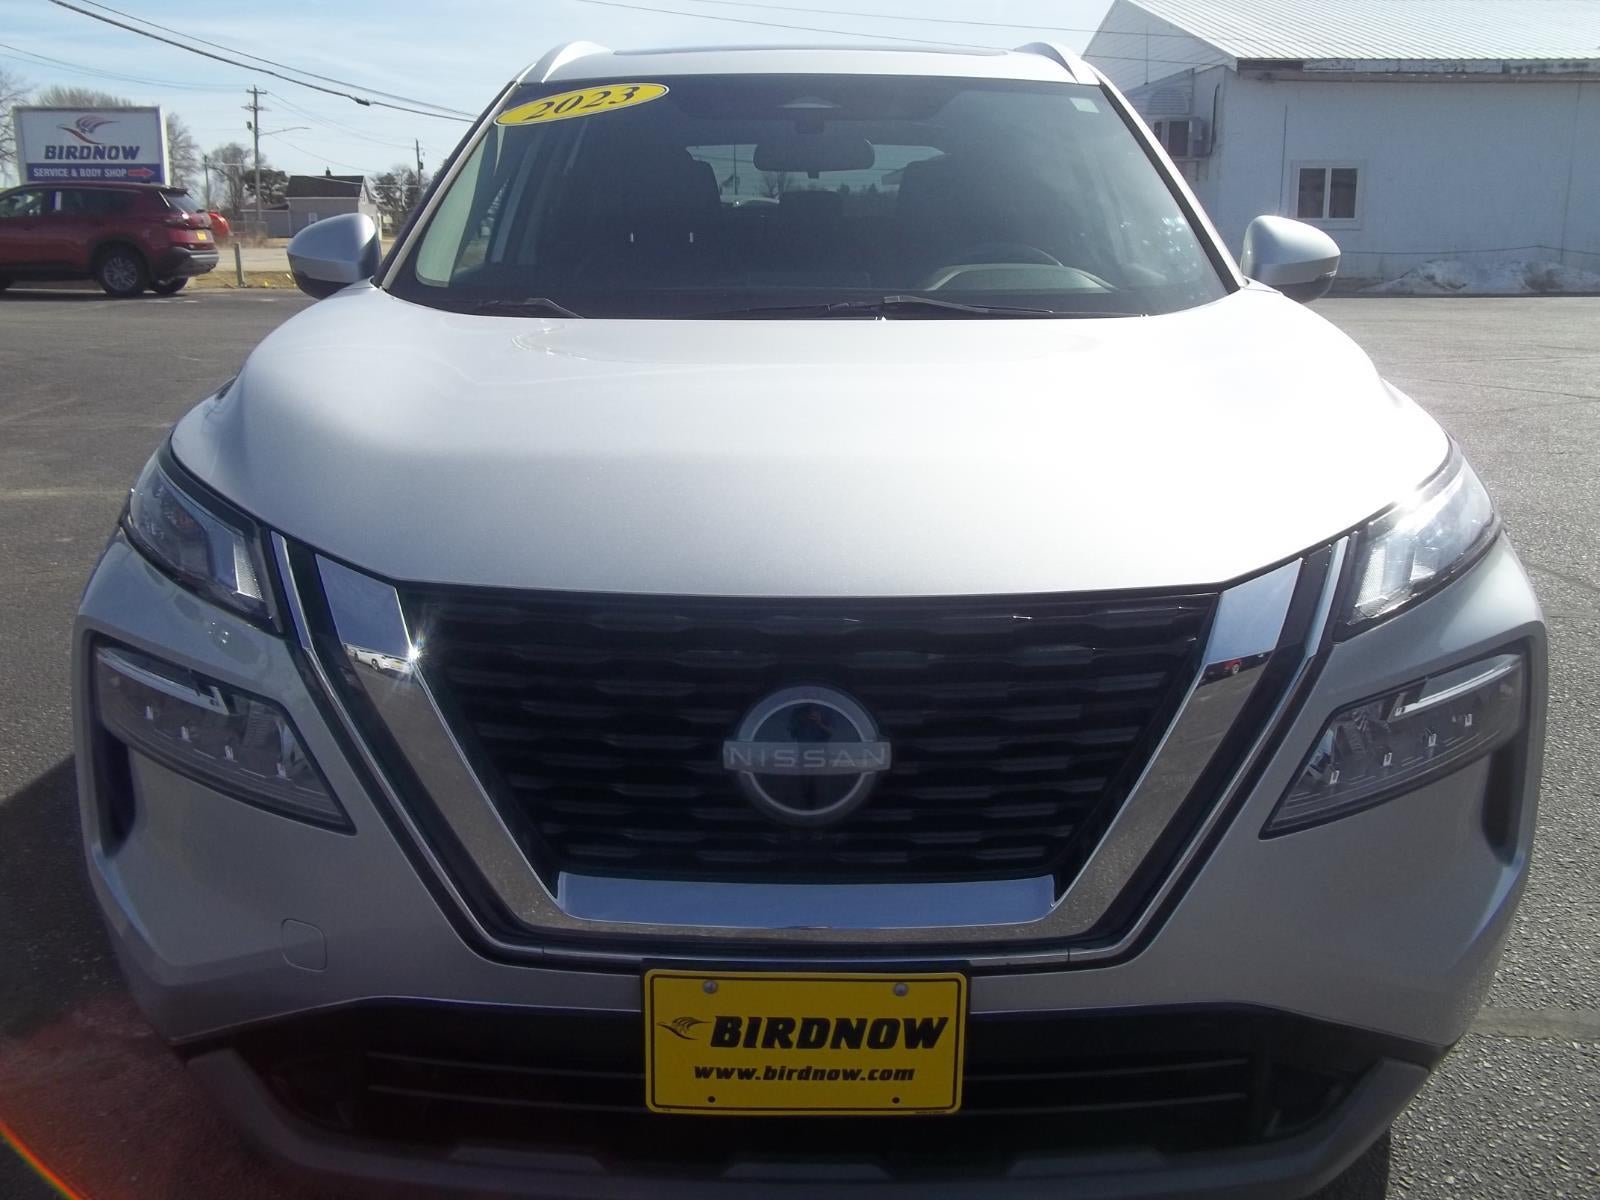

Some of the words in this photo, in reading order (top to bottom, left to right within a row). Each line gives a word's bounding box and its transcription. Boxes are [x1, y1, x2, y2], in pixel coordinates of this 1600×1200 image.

[523, 86, 640, 121] 2023
[44, 145, 140, 160] BIRDNOW
[33, 167, 69, 177] SERVICE
[70, 168, 78, 177] &
[79, 168, 102, 177] BODY
[104, 168, 127, 177] SHOP
[729, 747, 886, 768] NISSAN
[710, 1015, 949, 1049] BIRDNOW
[694, 1065, 915, 1081] www.birdnow.com
